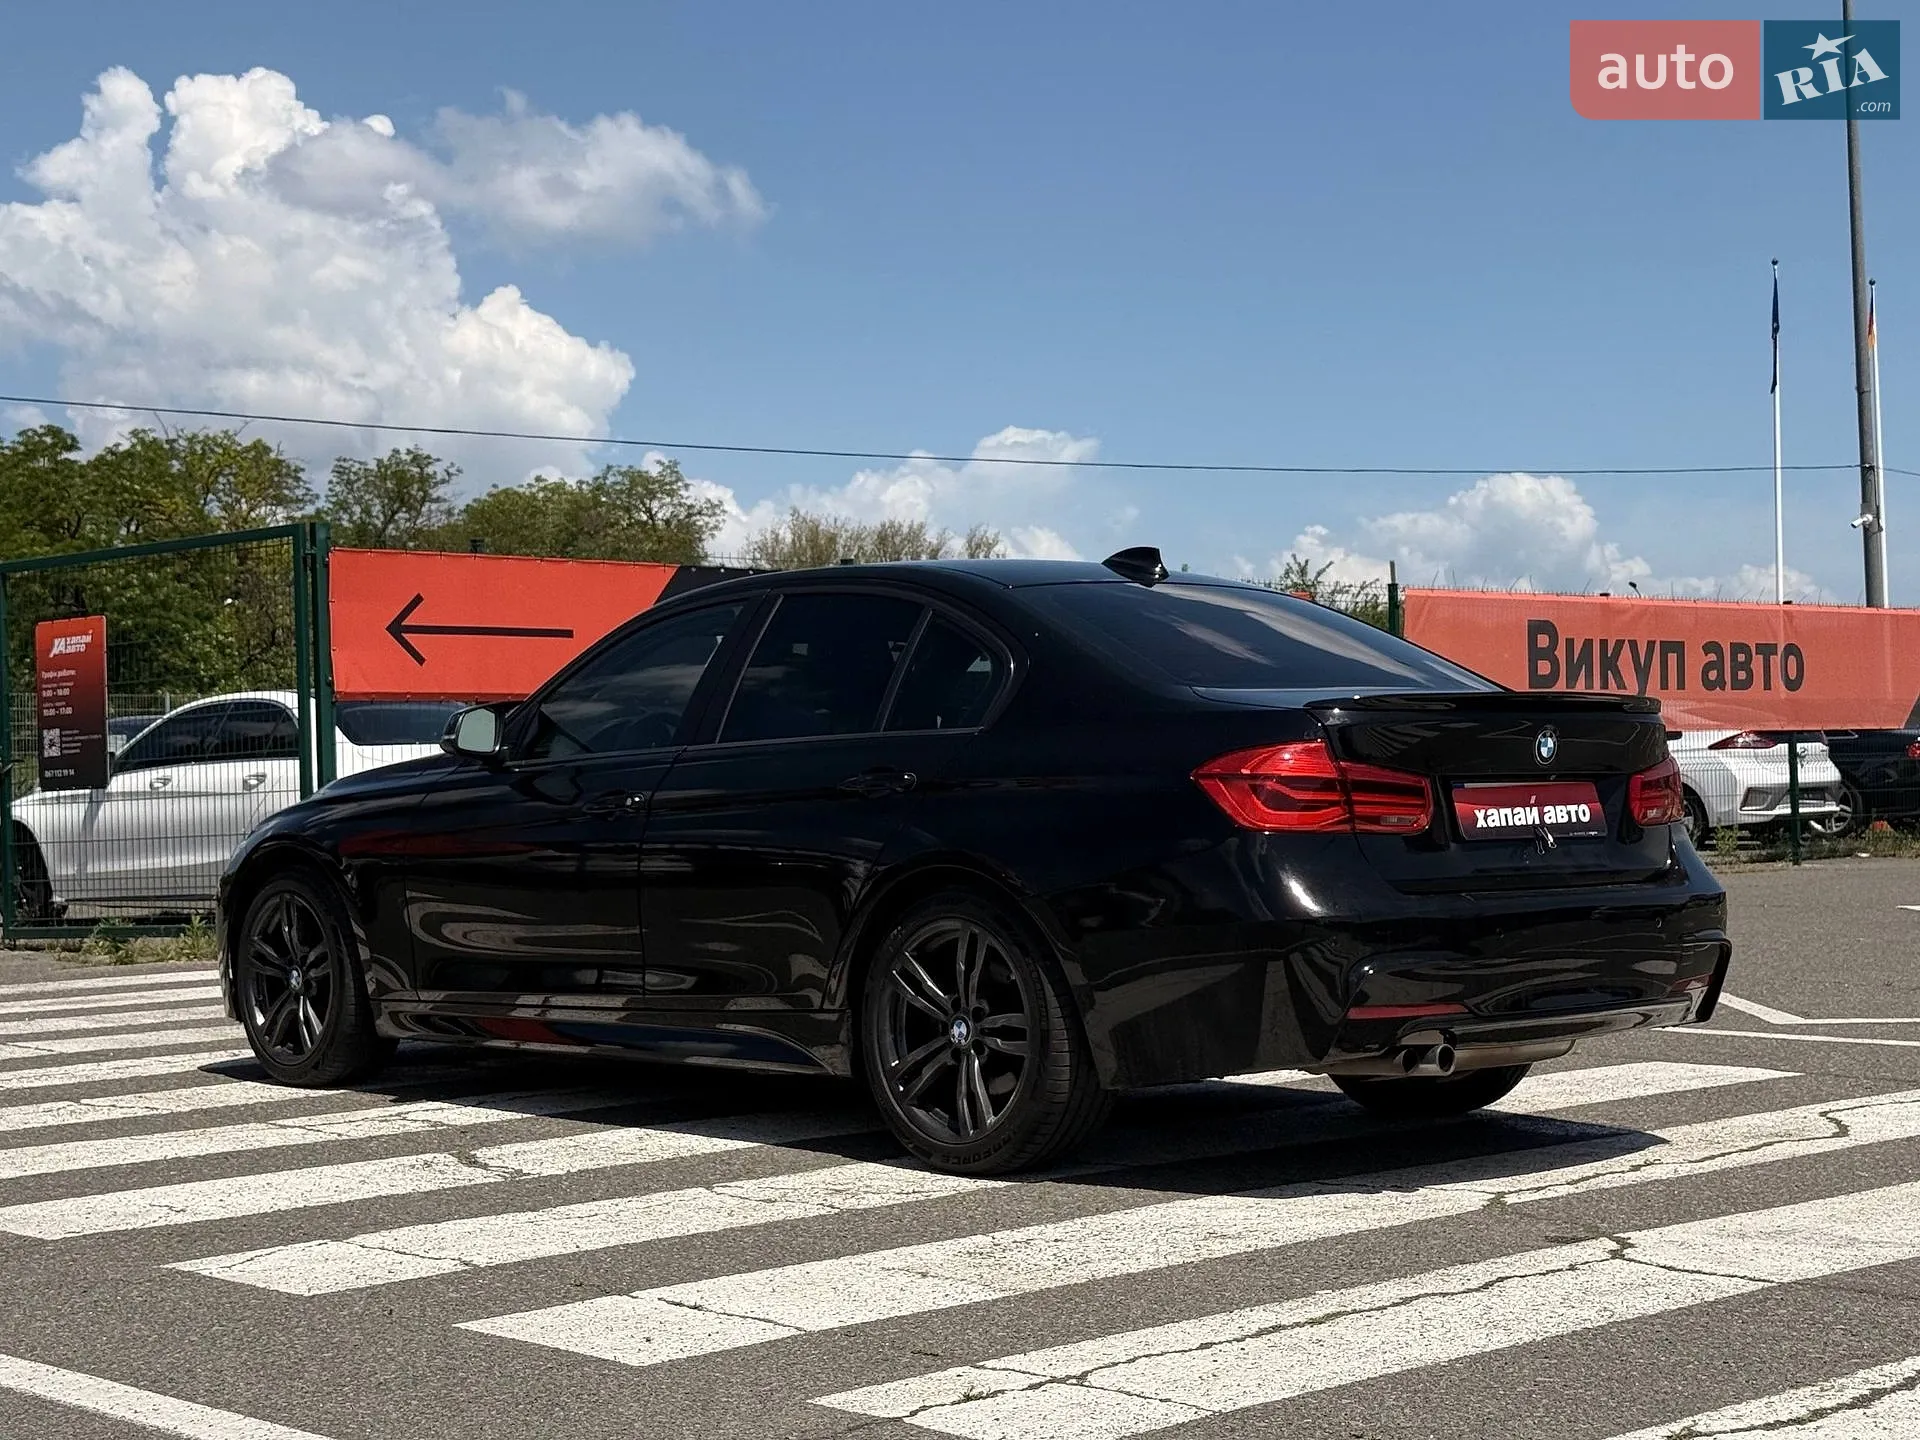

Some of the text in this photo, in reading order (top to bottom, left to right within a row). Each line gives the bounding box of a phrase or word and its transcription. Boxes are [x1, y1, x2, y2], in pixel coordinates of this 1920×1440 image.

[1527, 619, 1804, 697] Викуп авто
[1544, 804, 1591, 825] авто
